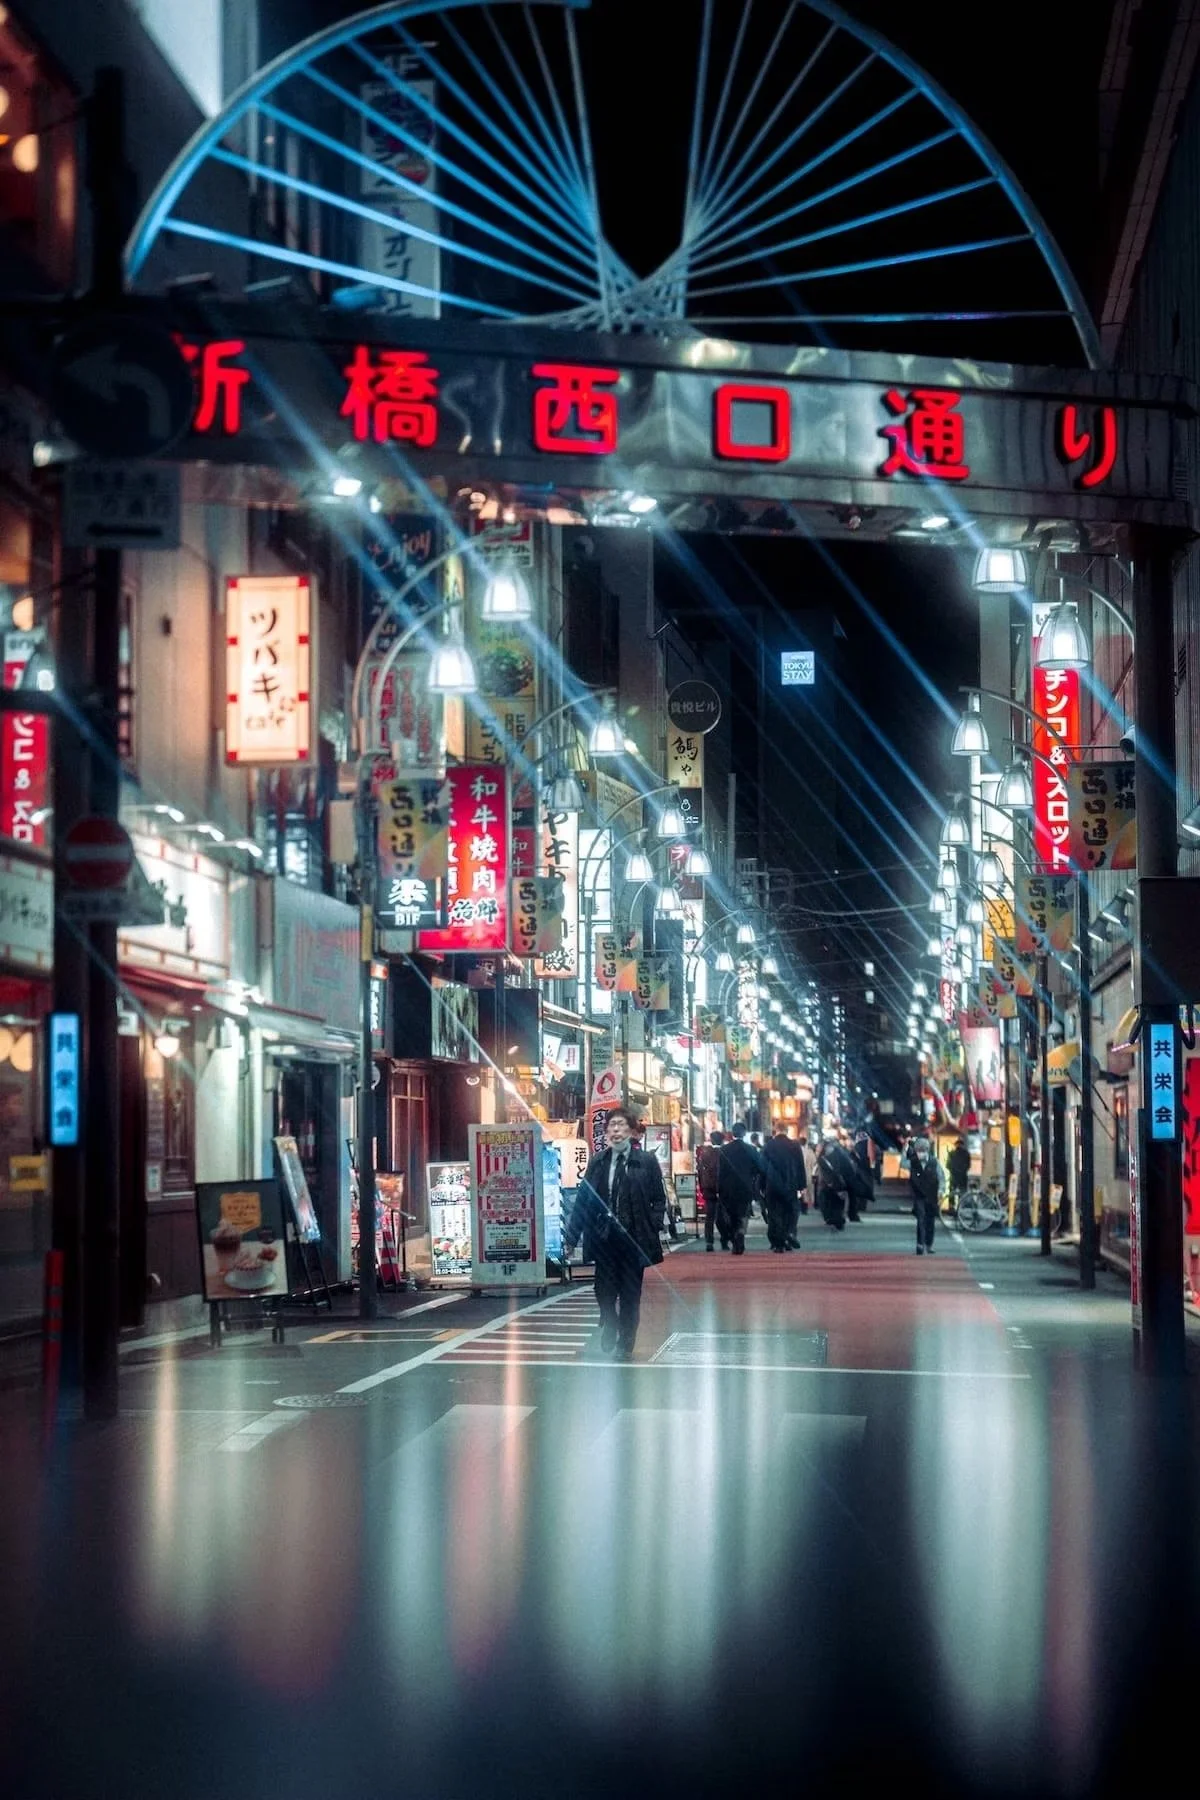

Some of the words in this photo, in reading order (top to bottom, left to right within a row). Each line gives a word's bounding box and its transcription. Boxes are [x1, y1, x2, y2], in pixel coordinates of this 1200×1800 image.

[250, 607, 280, 702] ツバキ
[783, 662, 812, 670] TOKYU
[783, 670, 812, 680] STAY
[469, 774, 499, 895] 和牛焼肉
[1154, 1039, 1173, 1124] 共栄会
[501, 1264, 517, 1277] 1F
